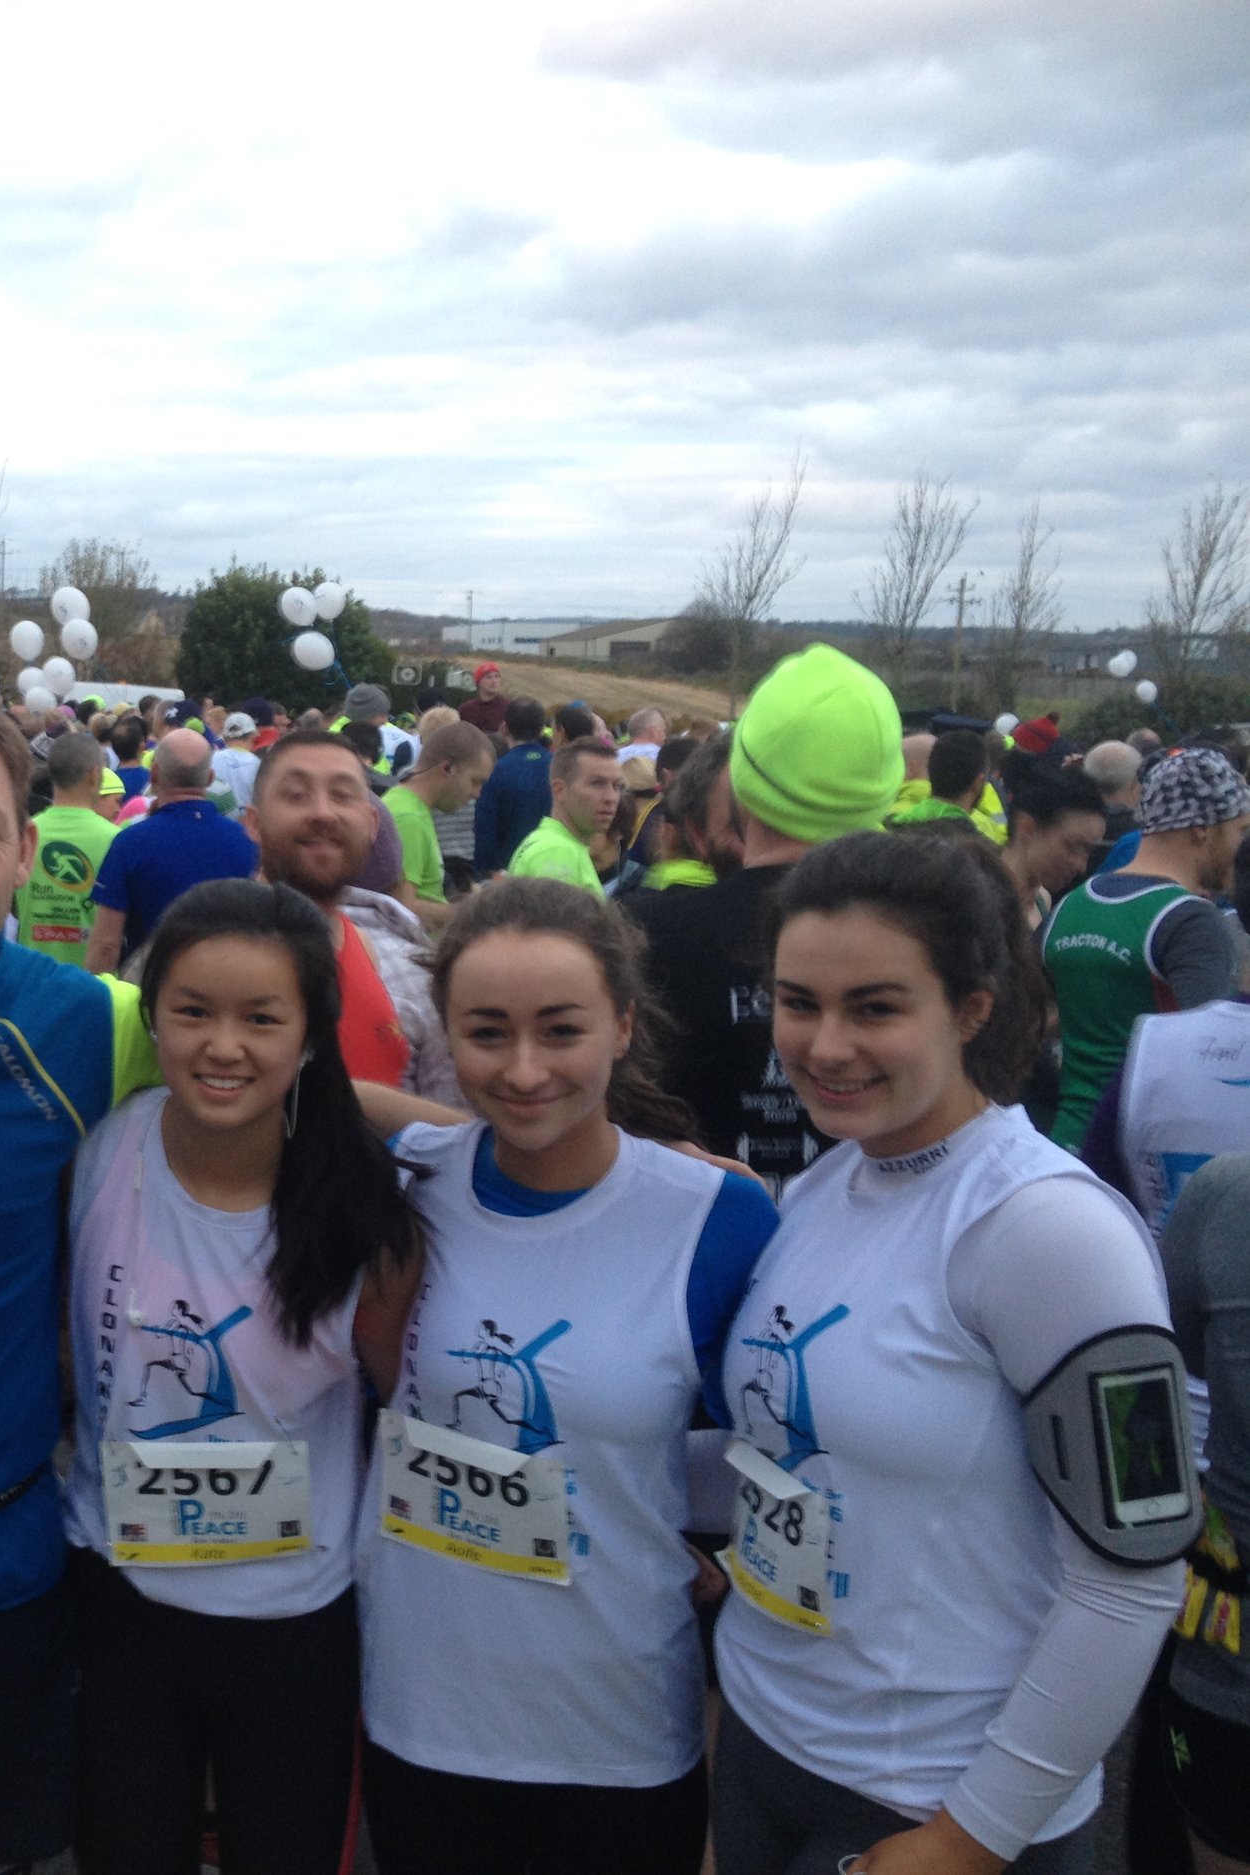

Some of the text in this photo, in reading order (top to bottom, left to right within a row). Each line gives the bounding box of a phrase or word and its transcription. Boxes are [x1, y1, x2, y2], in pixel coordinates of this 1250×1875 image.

[135, 1458, 274, 1496] 2567
[407, 1448, 531, 1508] 2566
[177, 1499, 249, 1536] PEACE
[434, 1486, 502, 1543] PEACE
